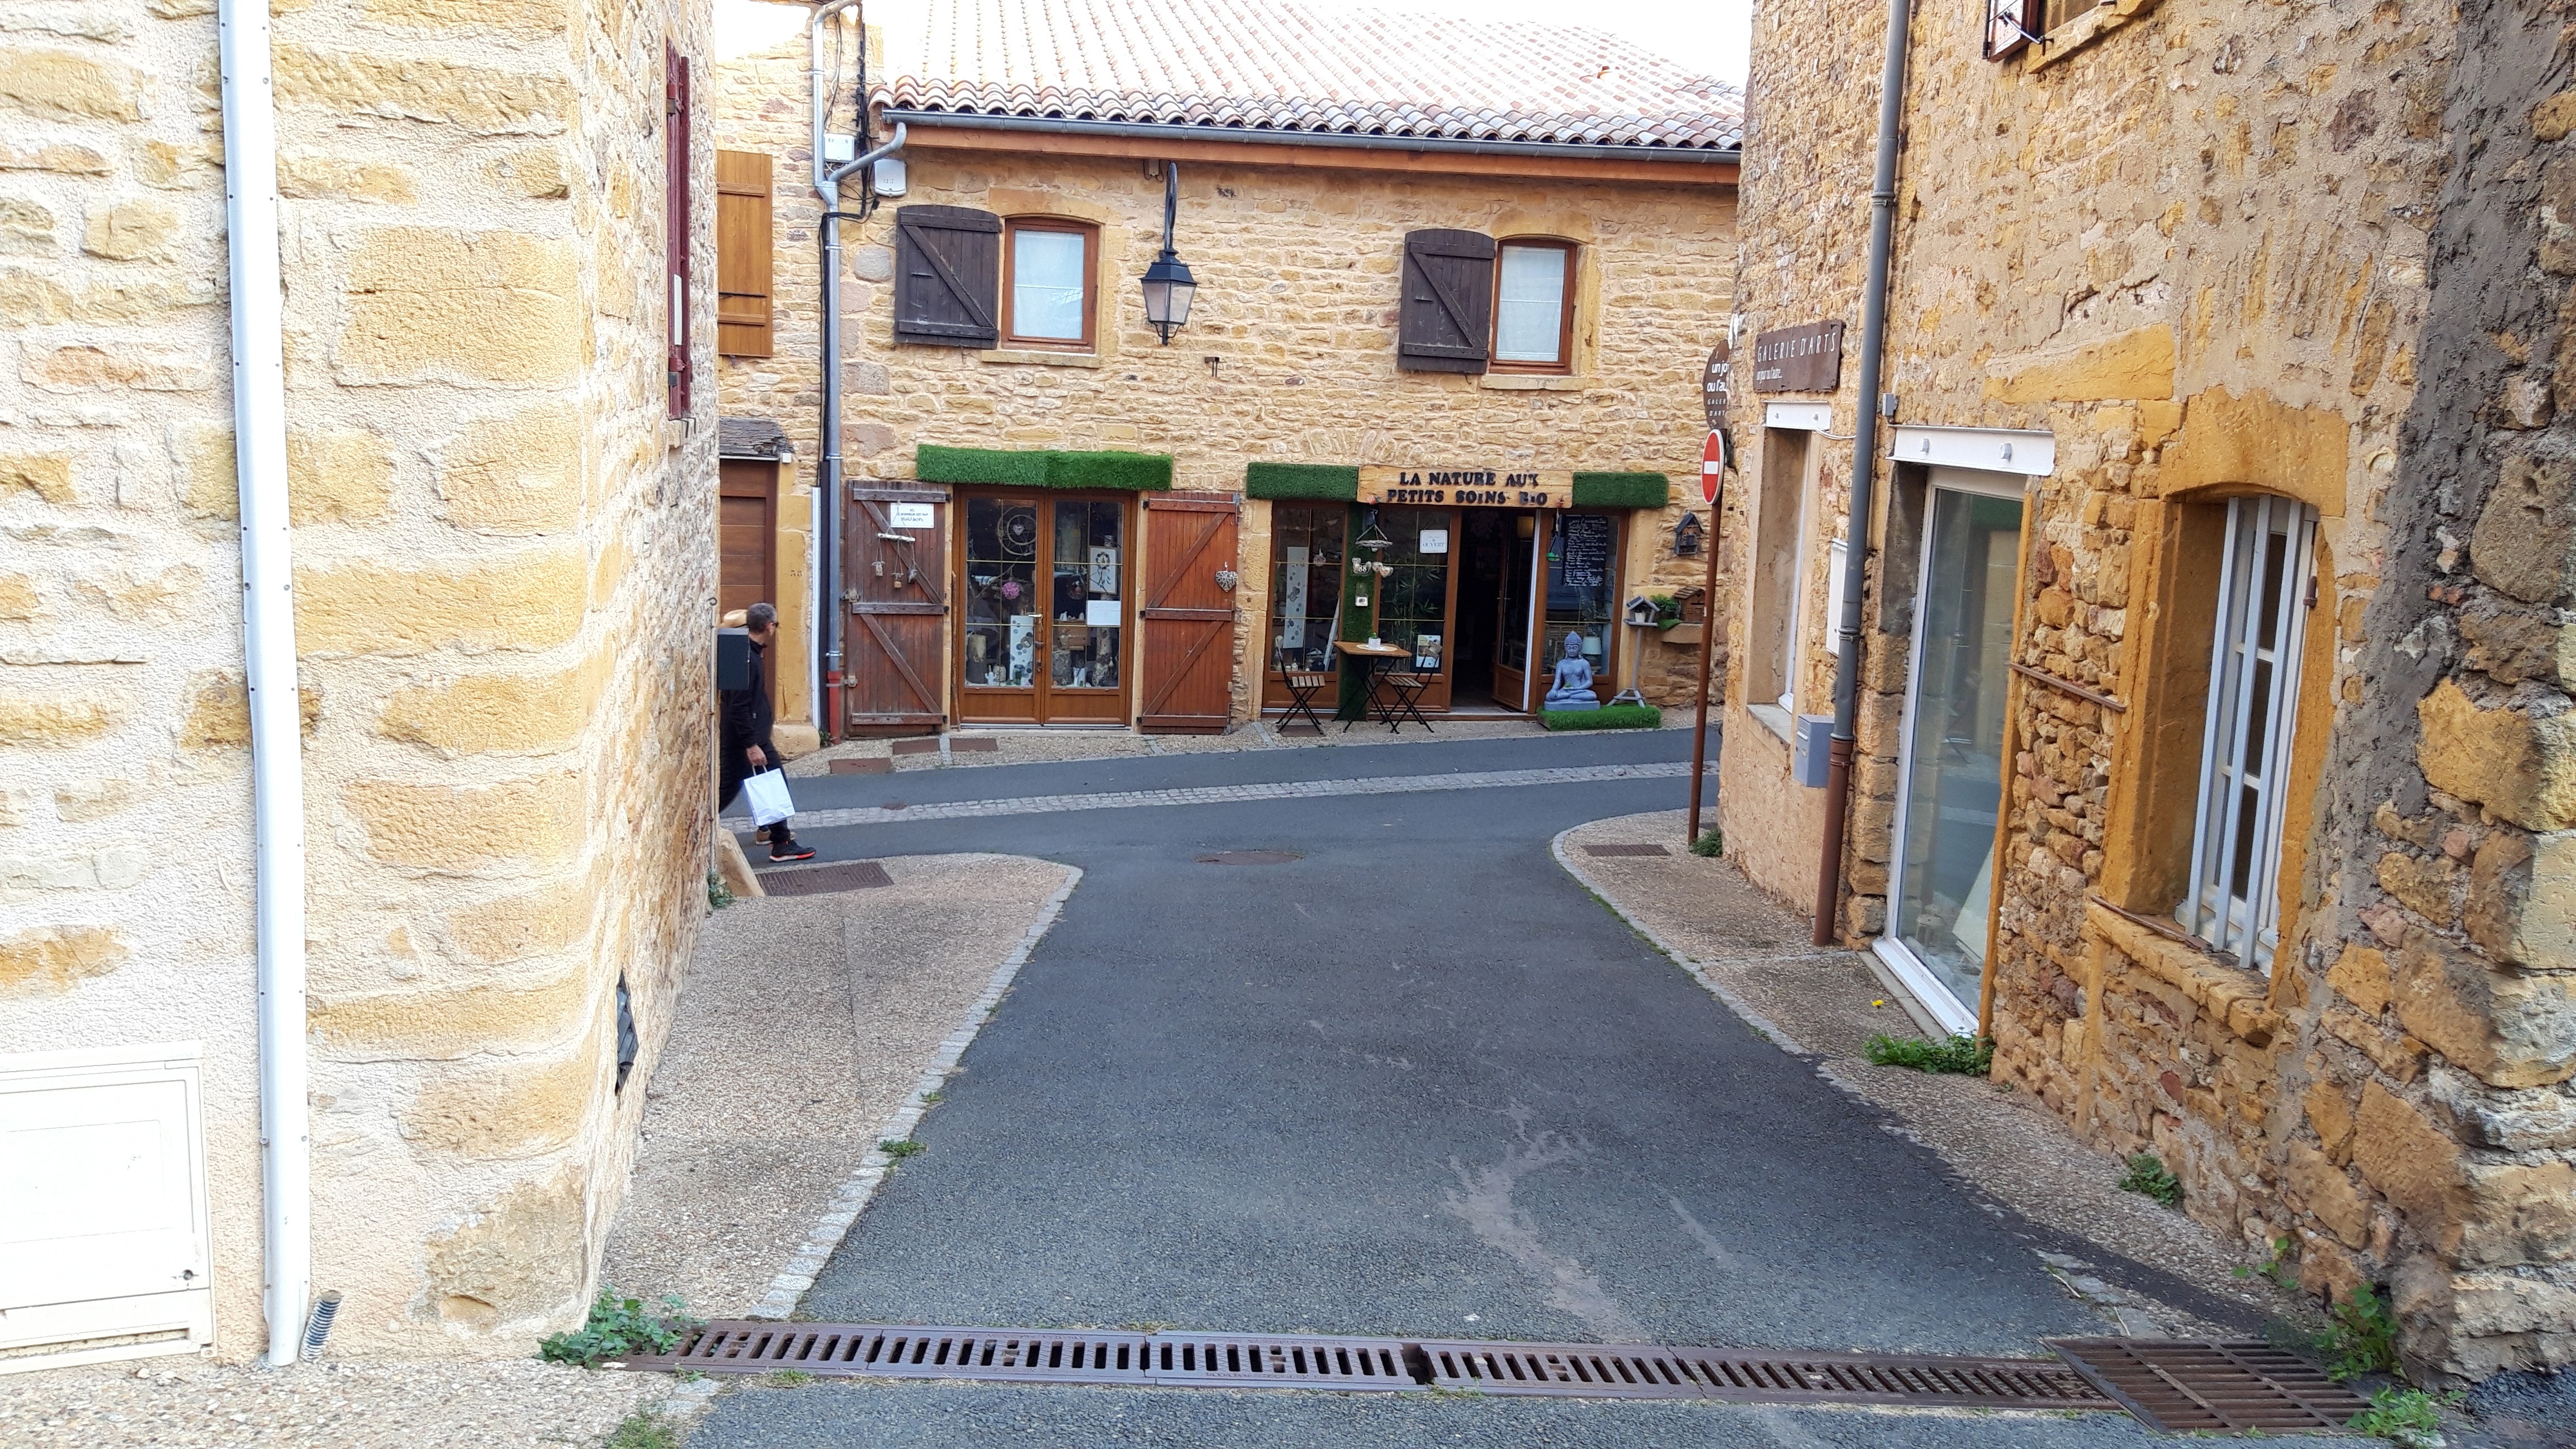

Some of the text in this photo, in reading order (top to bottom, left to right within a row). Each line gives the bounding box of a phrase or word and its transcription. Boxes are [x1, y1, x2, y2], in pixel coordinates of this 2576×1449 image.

[1757, 332, 1836, 363] GALERIE D'ARTS
[1711, 360, 1729, 377] un jo
[1707, 382, 1716, 392] ou
[1400, 472, 1539, 487] LA NATURE AUX
[1387, 489, 1547, 506] PETITS SOINS BIO
